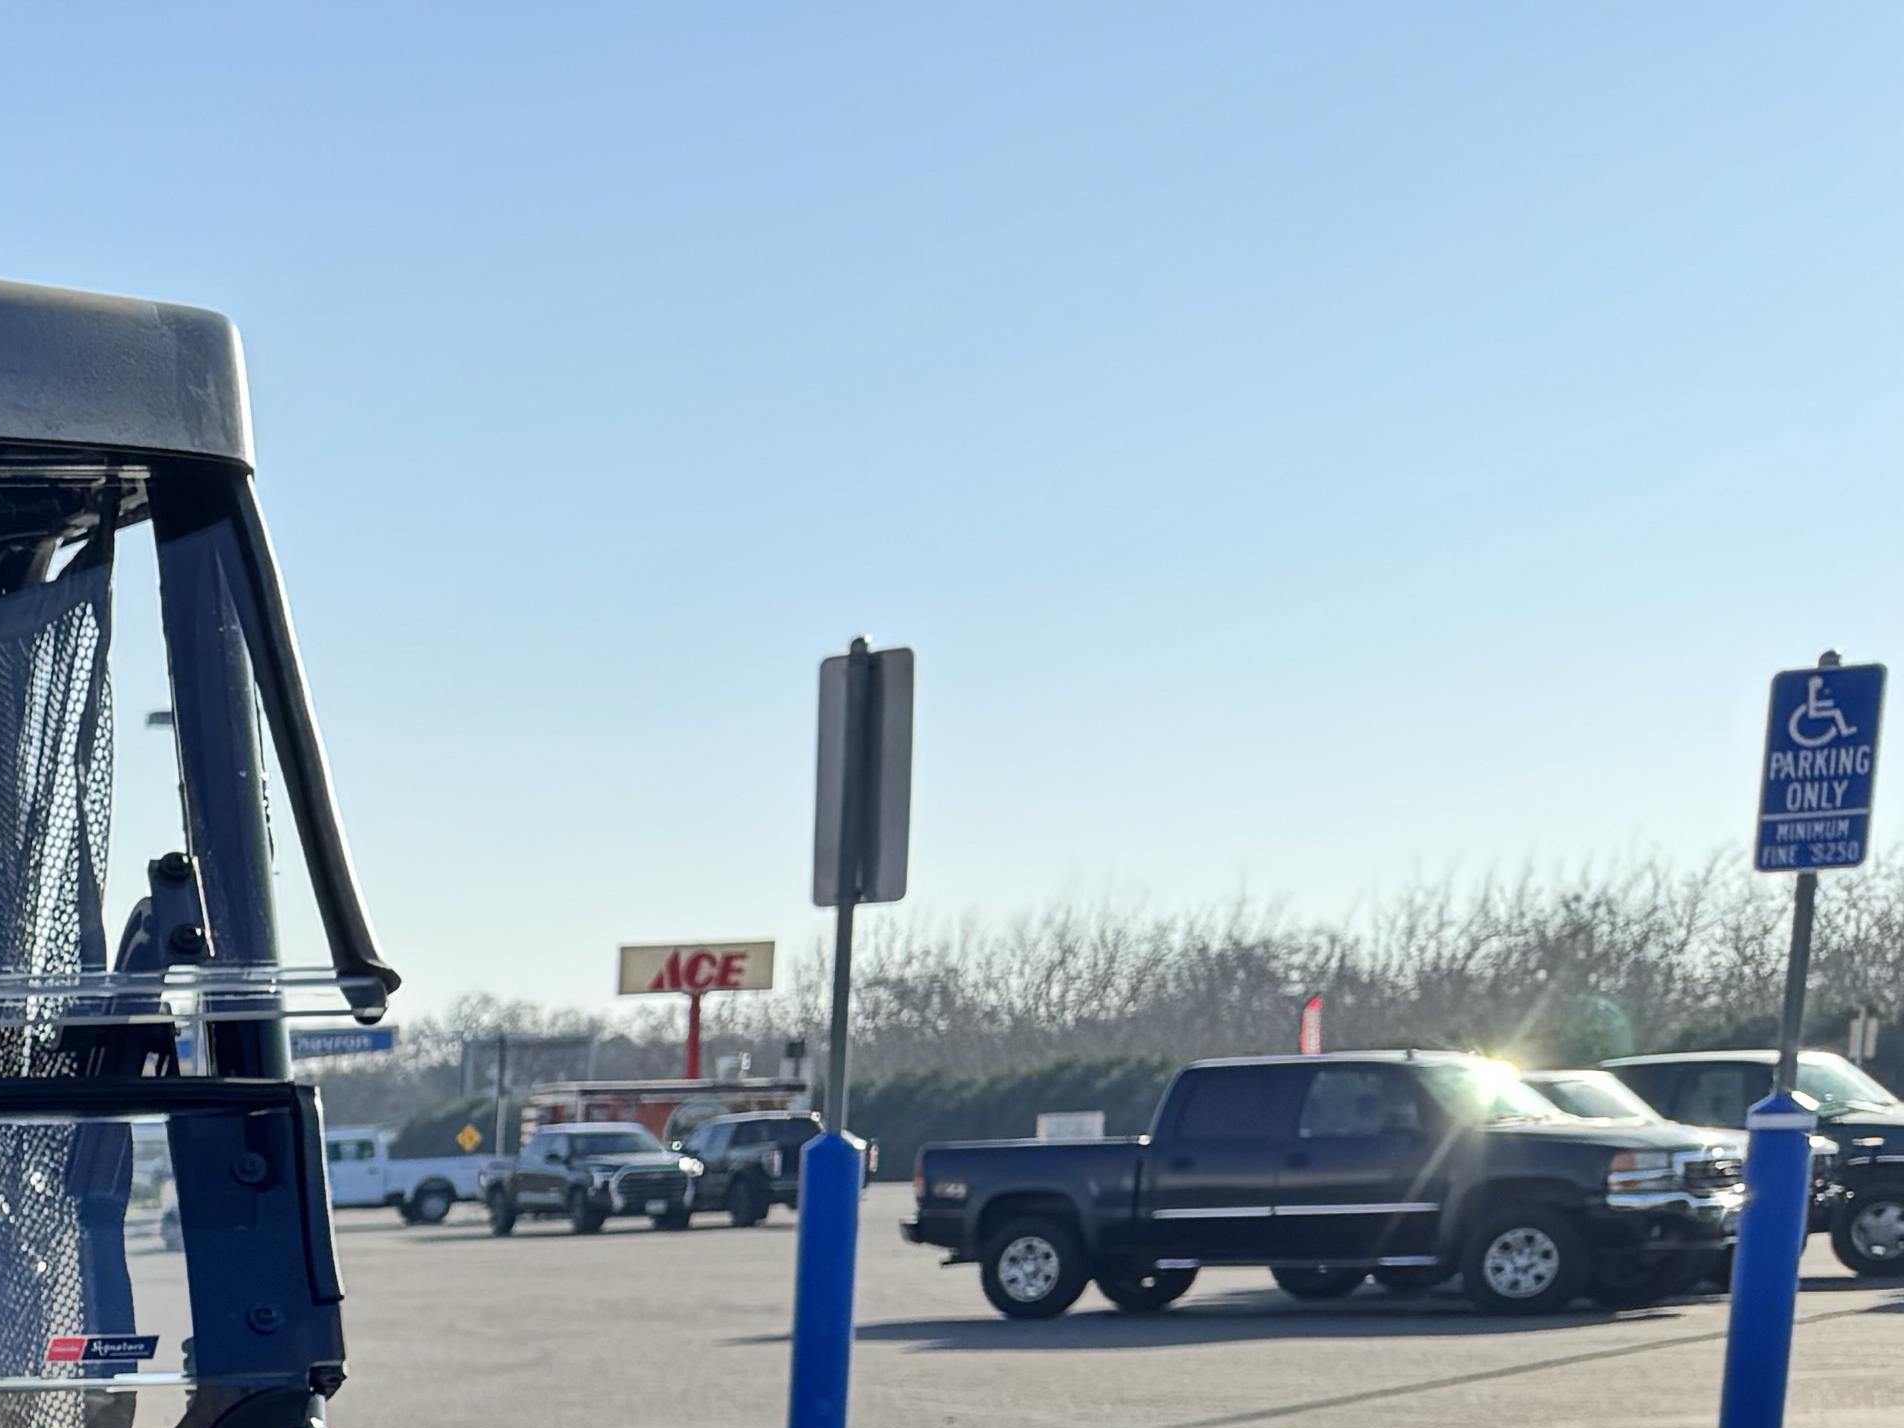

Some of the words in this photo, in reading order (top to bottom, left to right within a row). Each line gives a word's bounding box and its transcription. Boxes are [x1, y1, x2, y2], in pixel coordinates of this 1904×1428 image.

[1770, 746, 1870, 780] PARKING
[1786, 780, 1848, 811] ONLY
[1777, 819, 1849, 842] MINIMUM
[1762, 845, 1797, 866] FINE
[1809, 842, 1859, 863] $250
[649, 948, 748, 991] ACE
[295, 1034, 369, 1051] hevron
